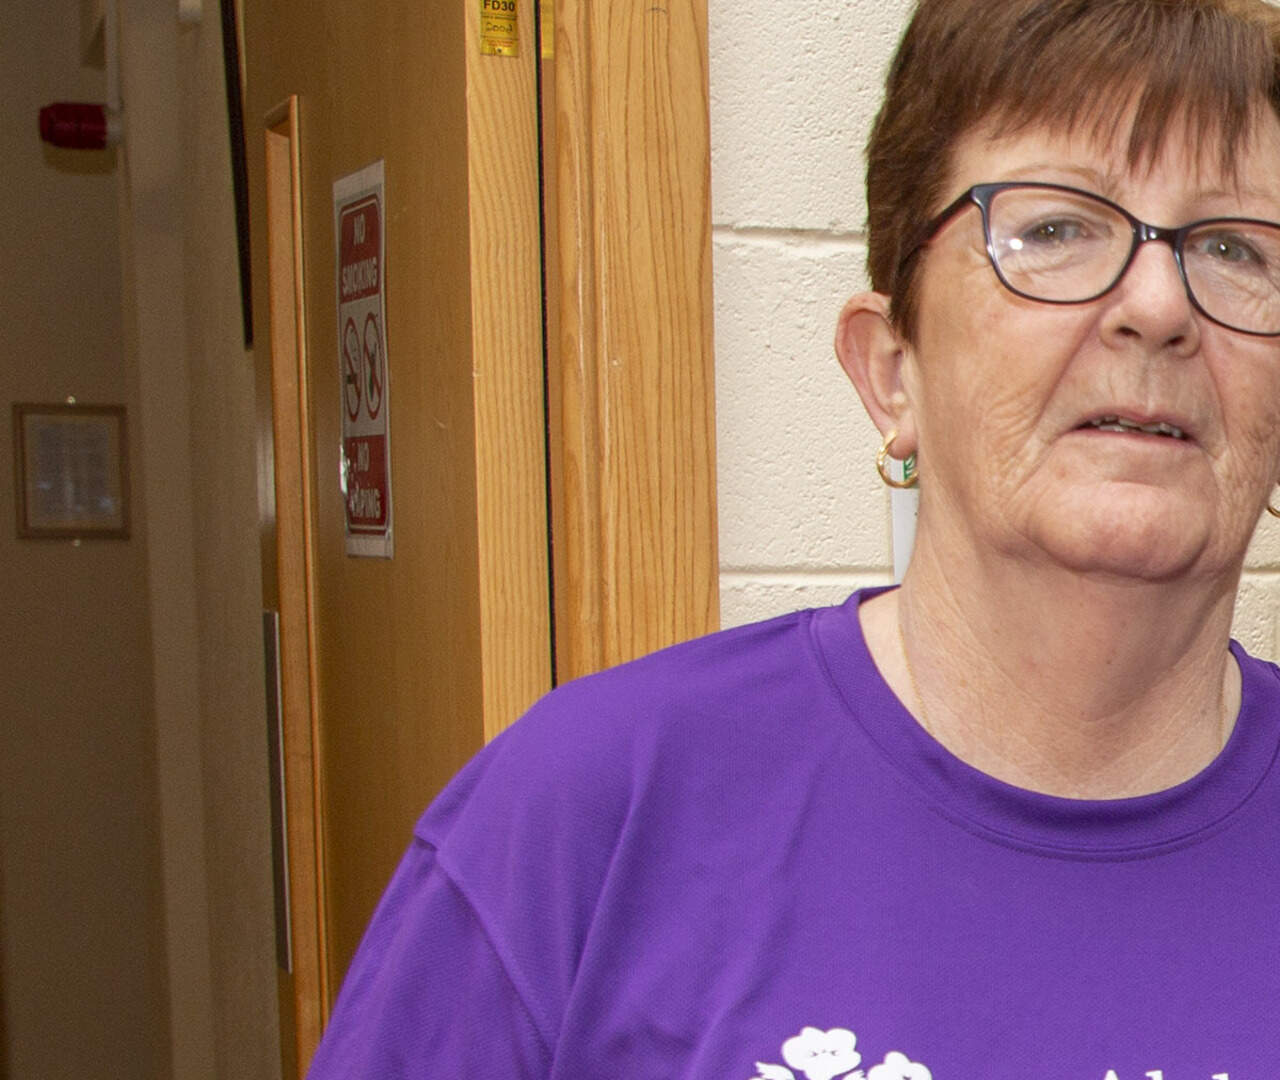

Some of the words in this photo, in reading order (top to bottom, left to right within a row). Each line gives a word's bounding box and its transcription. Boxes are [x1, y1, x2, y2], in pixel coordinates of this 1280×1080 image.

[483, 0, 516, 12] FD30
[353, 213, 366, 246] NO
[342, 256, 377, 297] SMOKING
